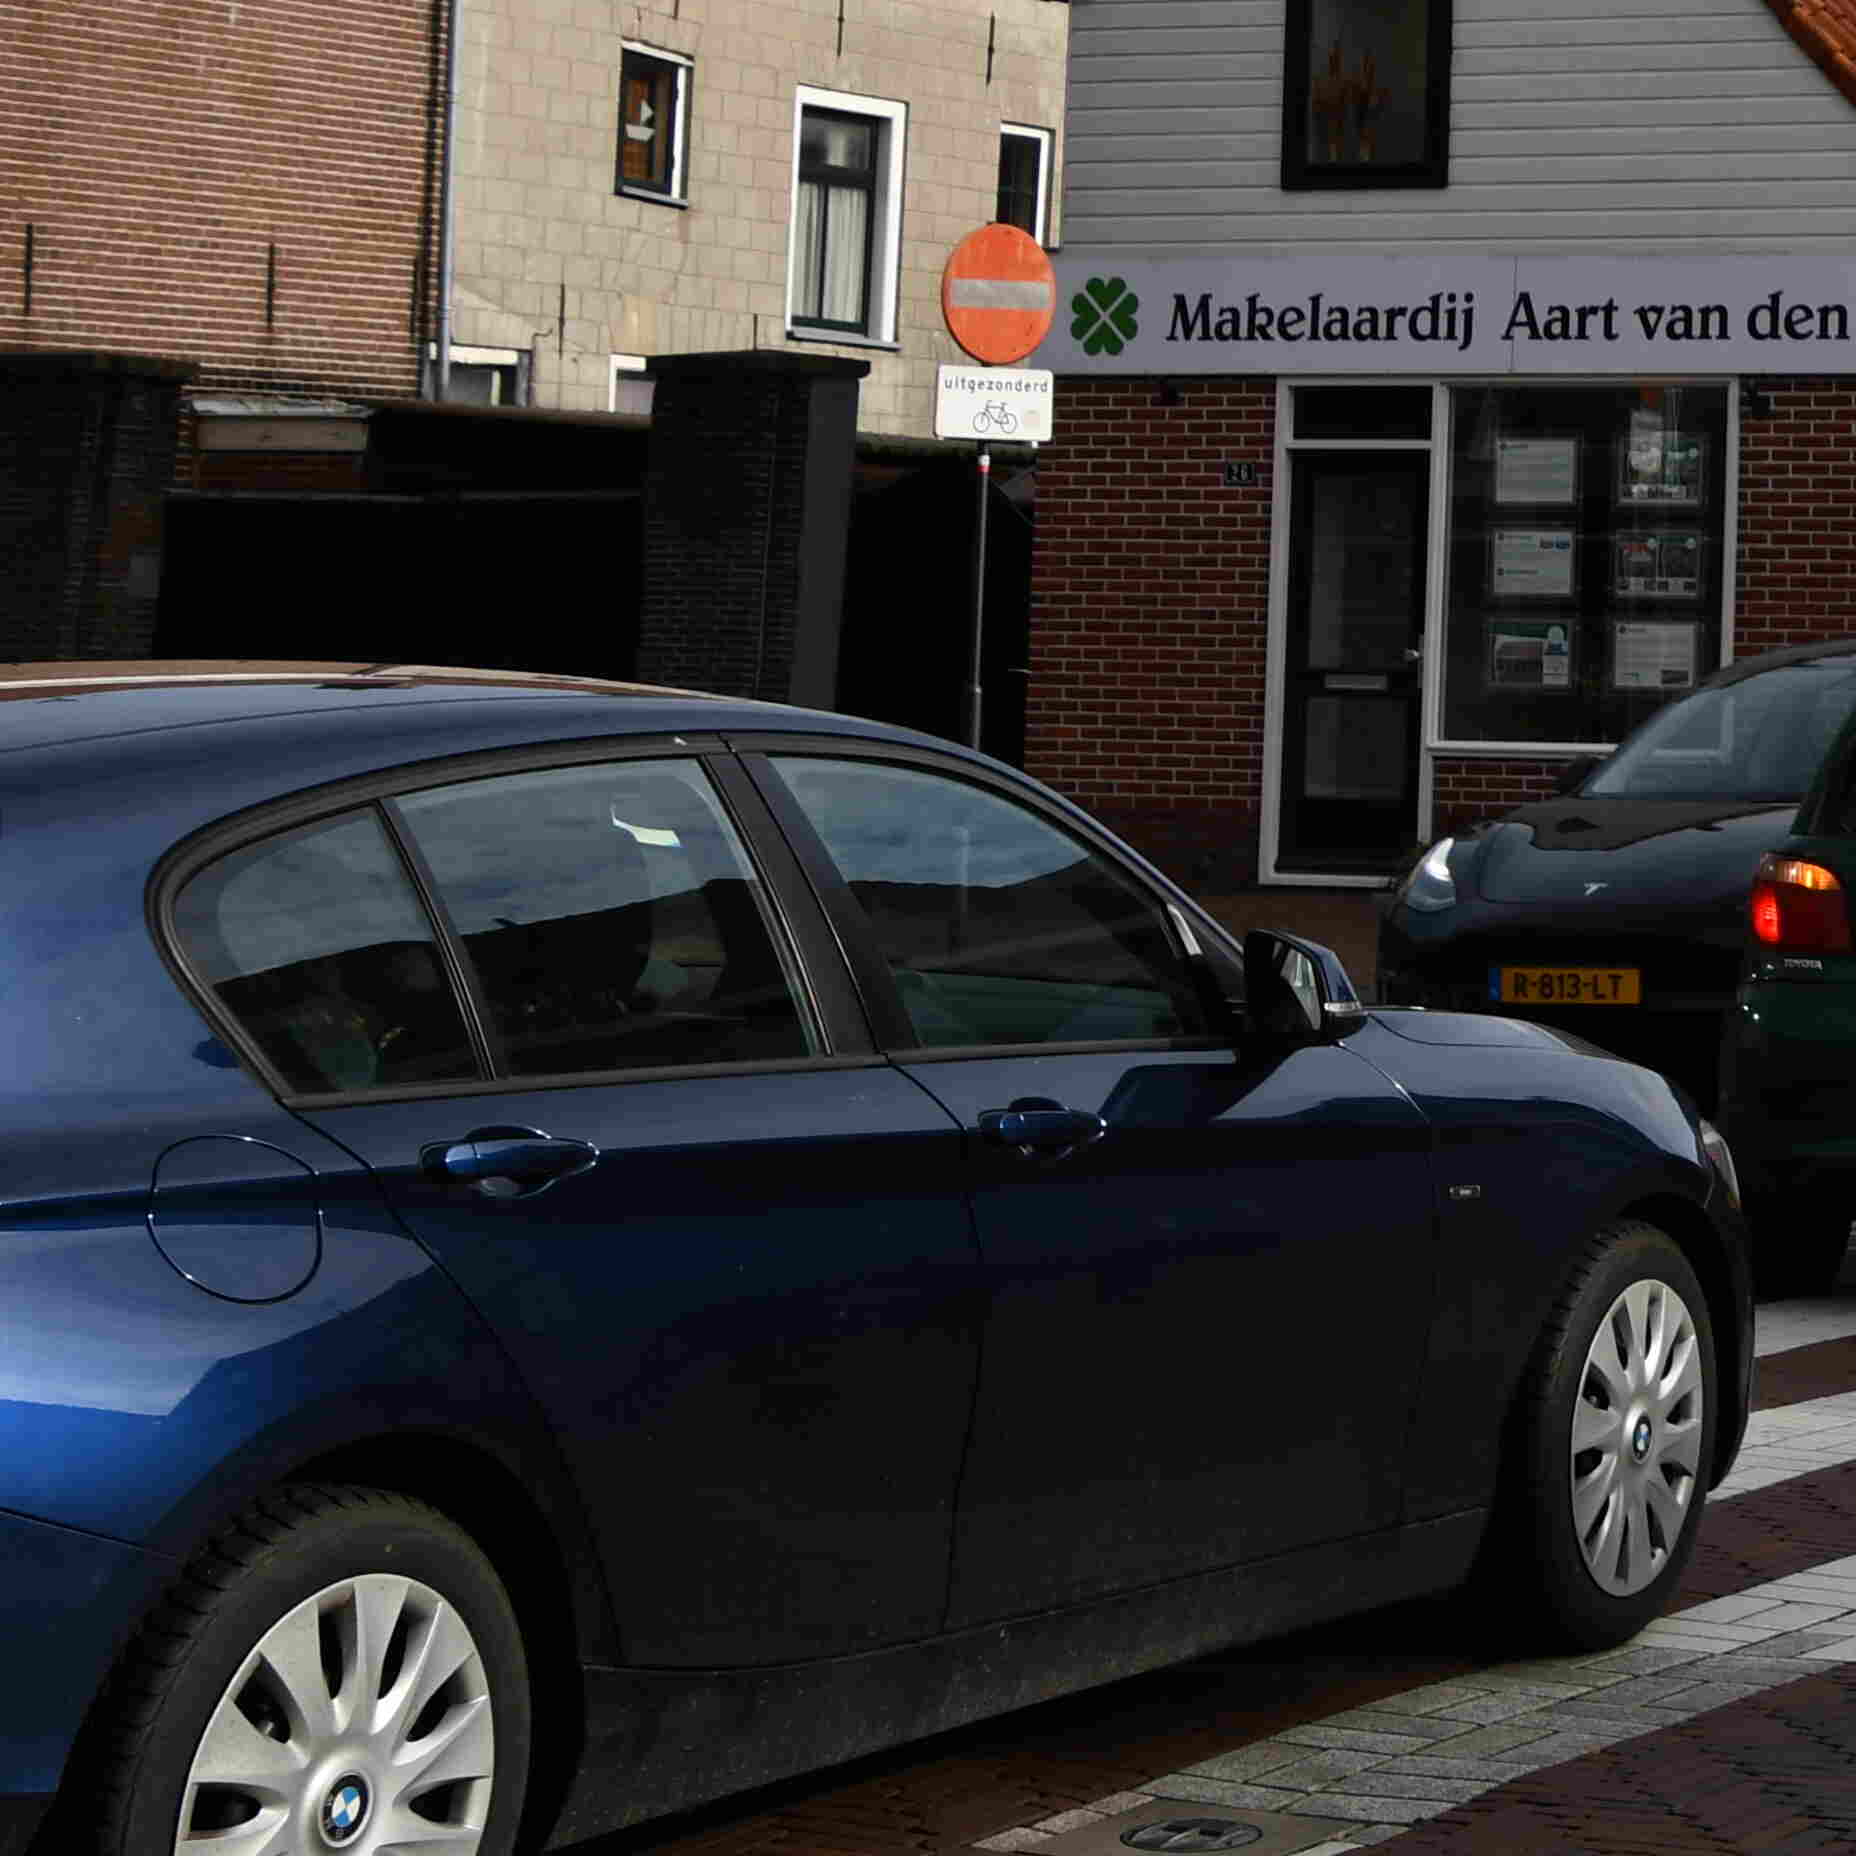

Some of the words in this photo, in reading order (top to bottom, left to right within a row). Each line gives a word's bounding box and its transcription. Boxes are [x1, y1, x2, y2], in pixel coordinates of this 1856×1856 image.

[1166, 293, 1475, 351] Makelaardij
[1502, 291, 1619, 340] Aart
[1634, 304, 1730, 340] van
[1747, 291, 1850, 340] den
[944, 375, 1048, 394] uitgezonderd
[1512, 972, 1624, 1000] R-813-LT
